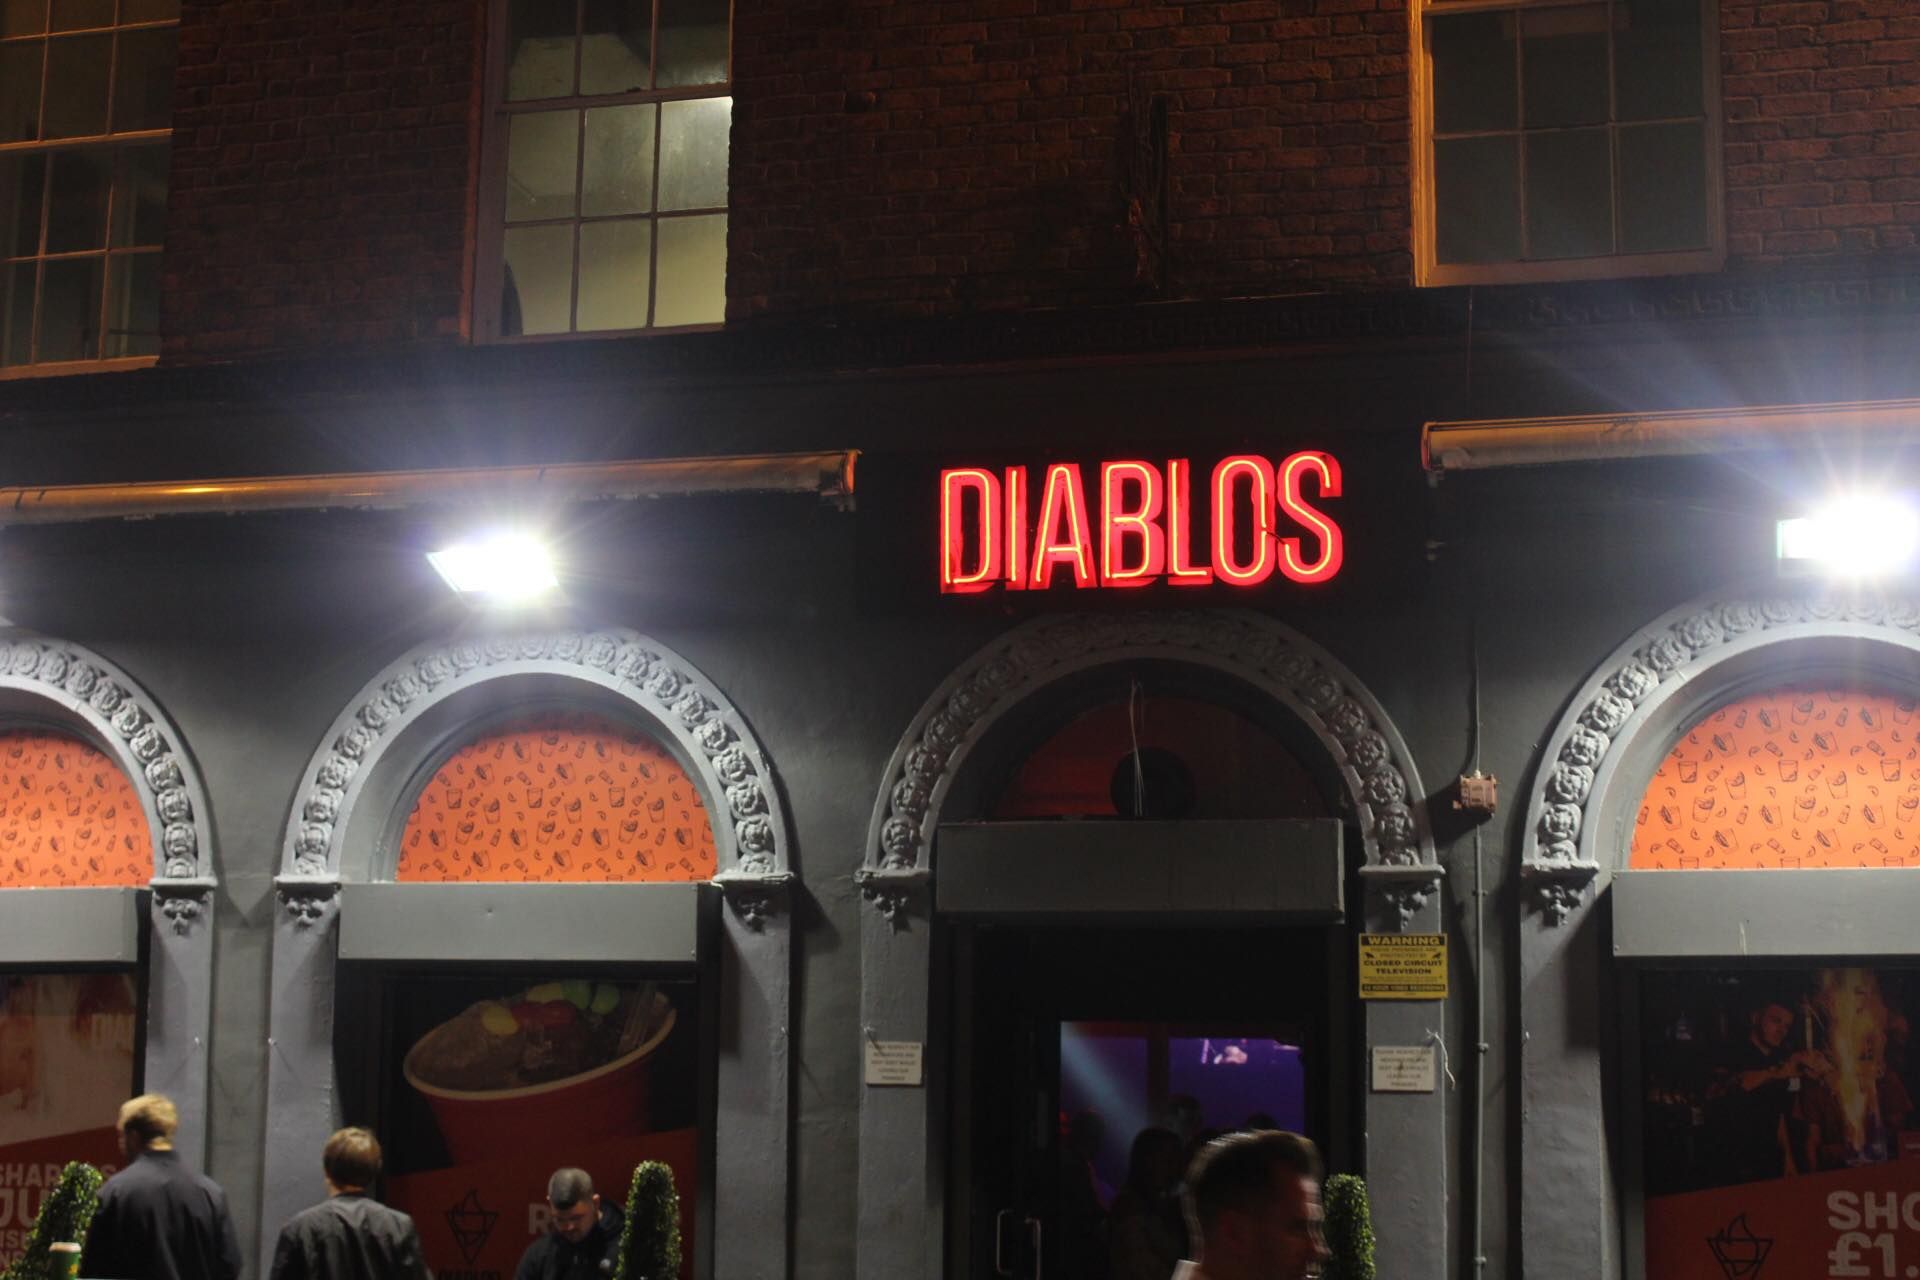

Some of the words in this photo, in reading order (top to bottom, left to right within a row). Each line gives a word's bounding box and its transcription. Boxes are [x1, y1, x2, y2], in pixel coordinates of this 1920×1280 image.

[940, 450, 1344, 594] DIABLOS
[1367, 936, 1441, 946] WARNING
[1363, 959, 1401, 967] CLOSED
[1403, 959, 1443, 967] CIRCUIT
[1375, 967, 1432, 975] TELEVISION
